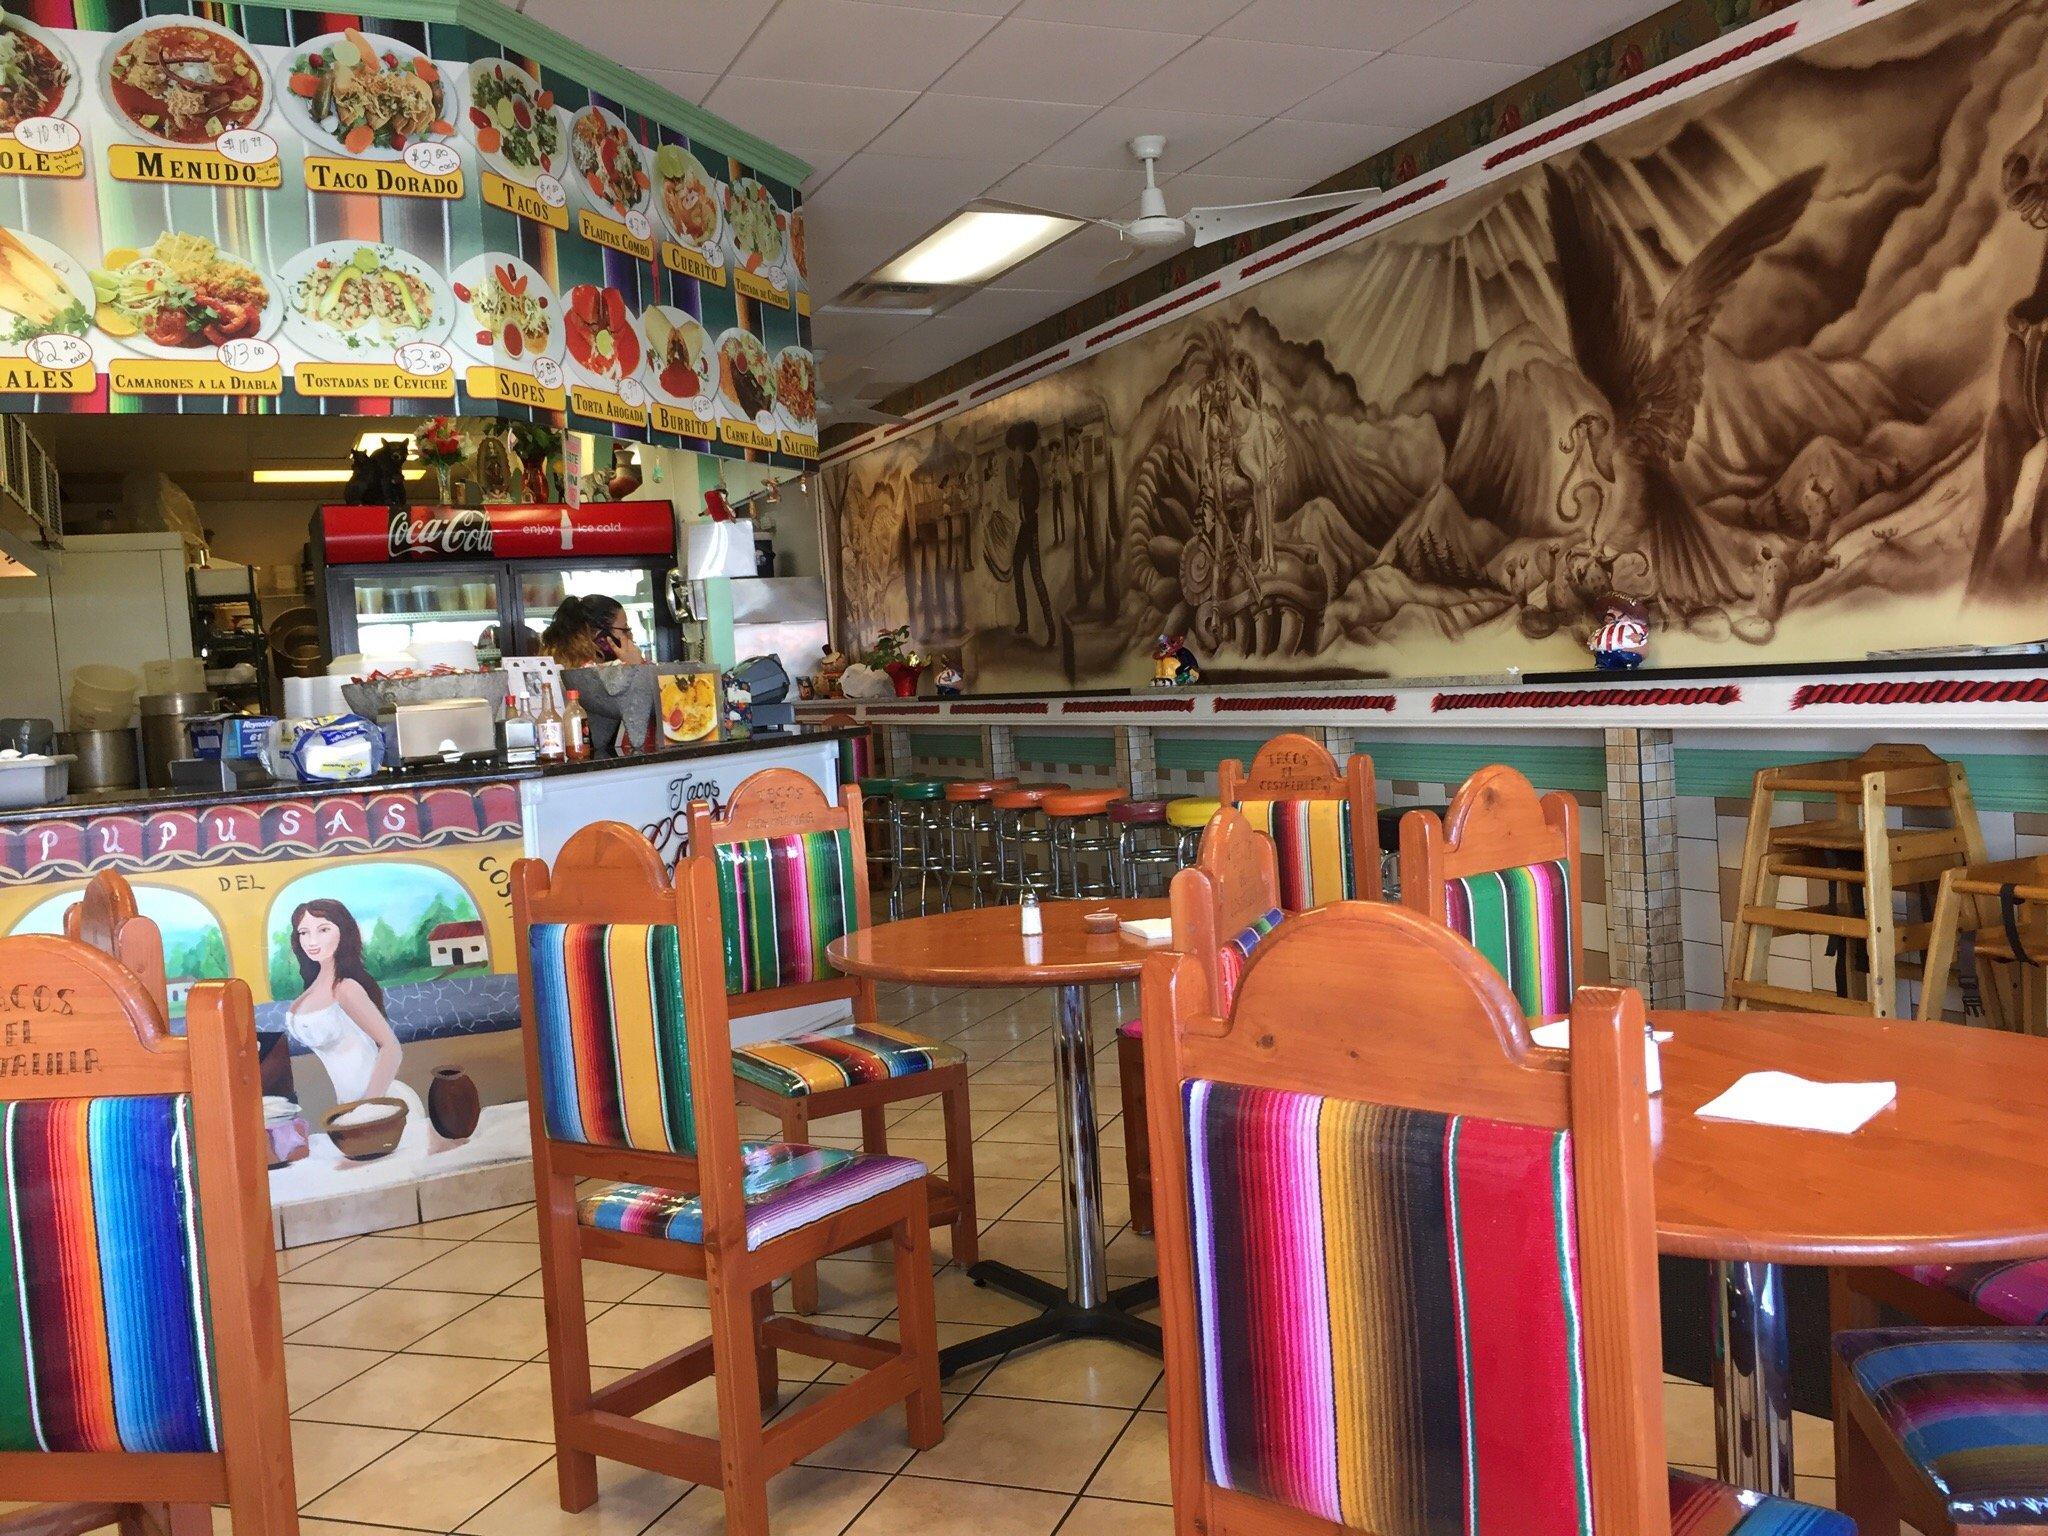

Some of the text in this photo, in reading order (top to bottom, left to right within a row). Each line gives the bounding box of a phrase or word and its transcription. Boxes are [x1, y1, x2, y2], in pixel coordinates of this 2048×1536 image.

[135, 150, 256, 183] MENUDO
[312, 164, 458, 195] TACO DORADO
[502, 182, 550, 221] TACOS
[583, 218, 620, 247] FLAUTAS
[622, 234, 650, 258] COMBO
[671, 248, 718, 282] CUERITO
[70, 349, 88, 364] each
[0, 370, 74, 389] ALES
[115, 374, 278, 390] CAMARONES A LA DIABLA
[302, 373, 448, 390] TOSTADAS DE CEVICHE
[500, 373, 546, 403] SOPES
[573, 393, 644, 423] TORTA AHOGADA
[660, 408, 708, 436] BURRITO
[726, 425, 773, 448] CARNE ASADA
[388, 510, 623, 557] Coca-Cola enjoy ice cold
[669, 773, 721, 812] Tacos
[38, 803, 407, 861] PUPUSAS
[219, 875, 266, 892] DEL
[479, 856, 513, 918] COS
[0, 984, 75, 1016] COS
[5, 1019, 37, 1047] EL
